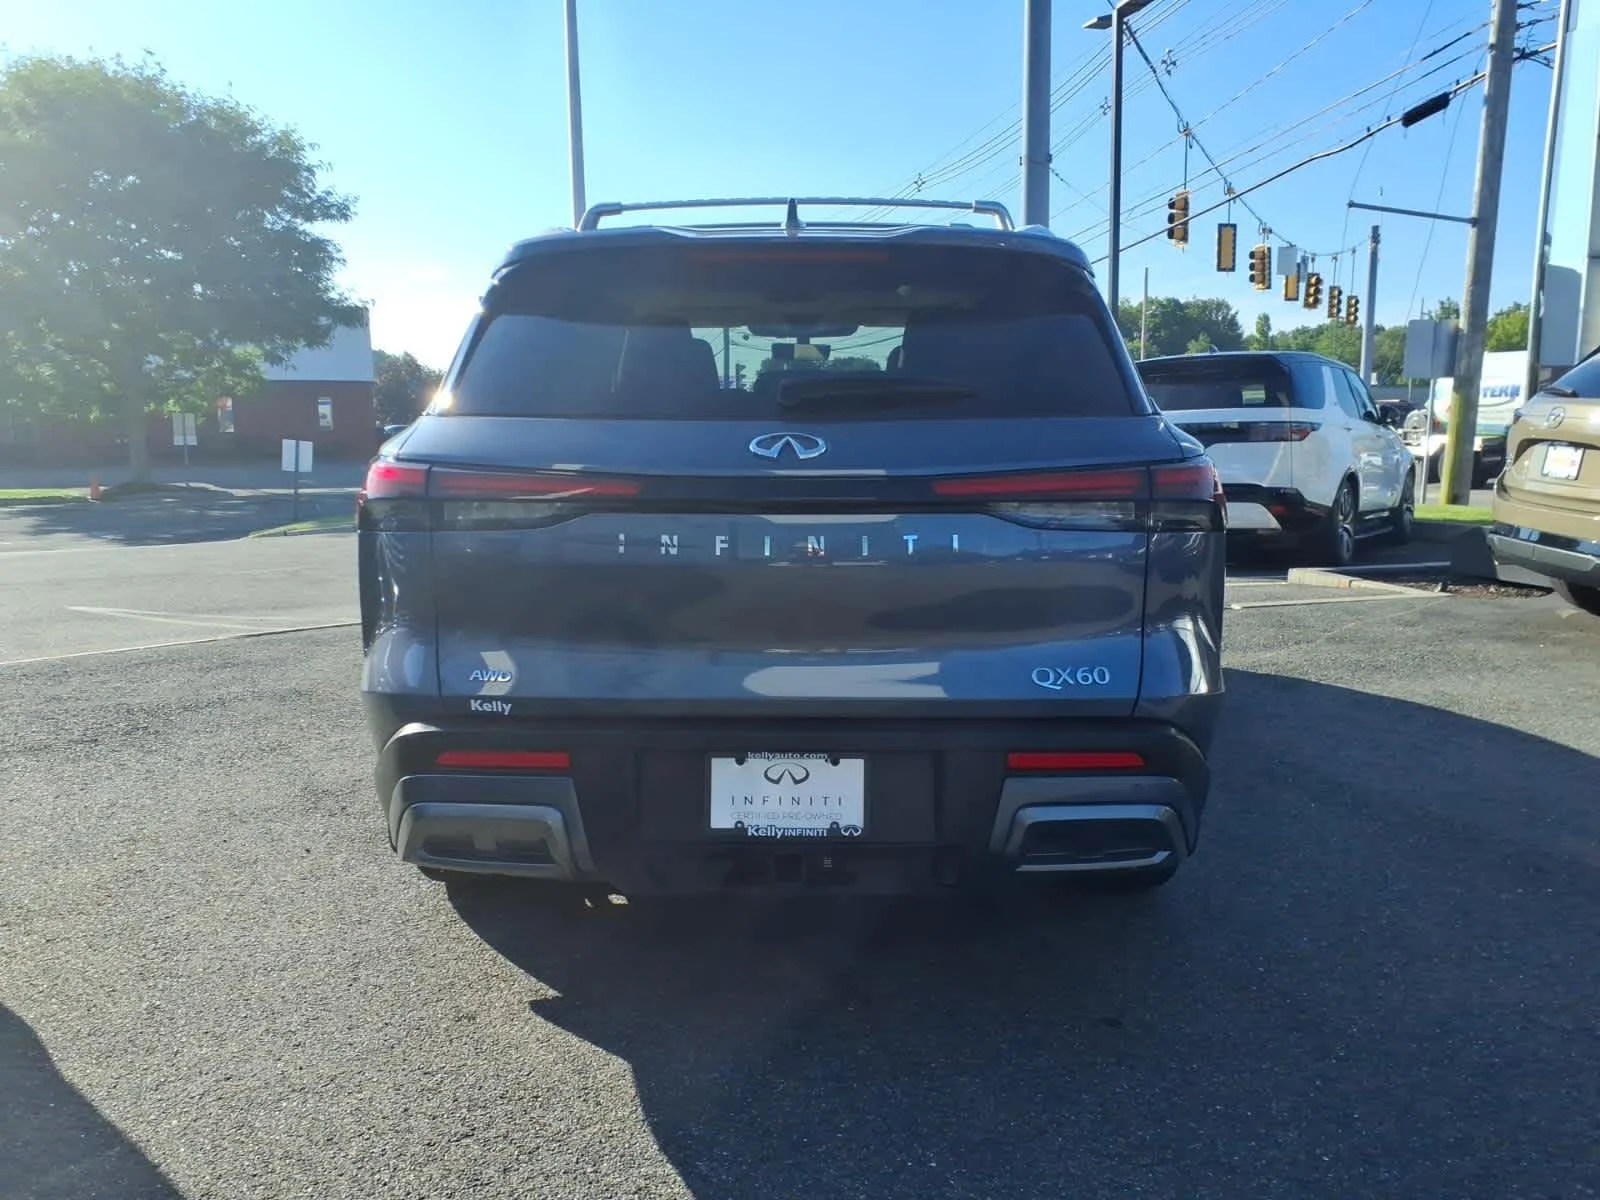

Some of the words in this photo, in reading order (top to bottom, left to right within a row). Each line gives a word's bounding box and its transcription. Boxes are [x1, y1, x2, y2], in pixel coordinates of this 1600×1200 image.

[618, 534, 960, 556] INFINITI
[469, 669, 512, 682] AWD
[1031, 666, 1110, 690] QX60
[470, 699, 512, 716] Kelly
[747, 751, 829, 761] kellyauto.com
[731, 795, 842, 807] INFINITI
